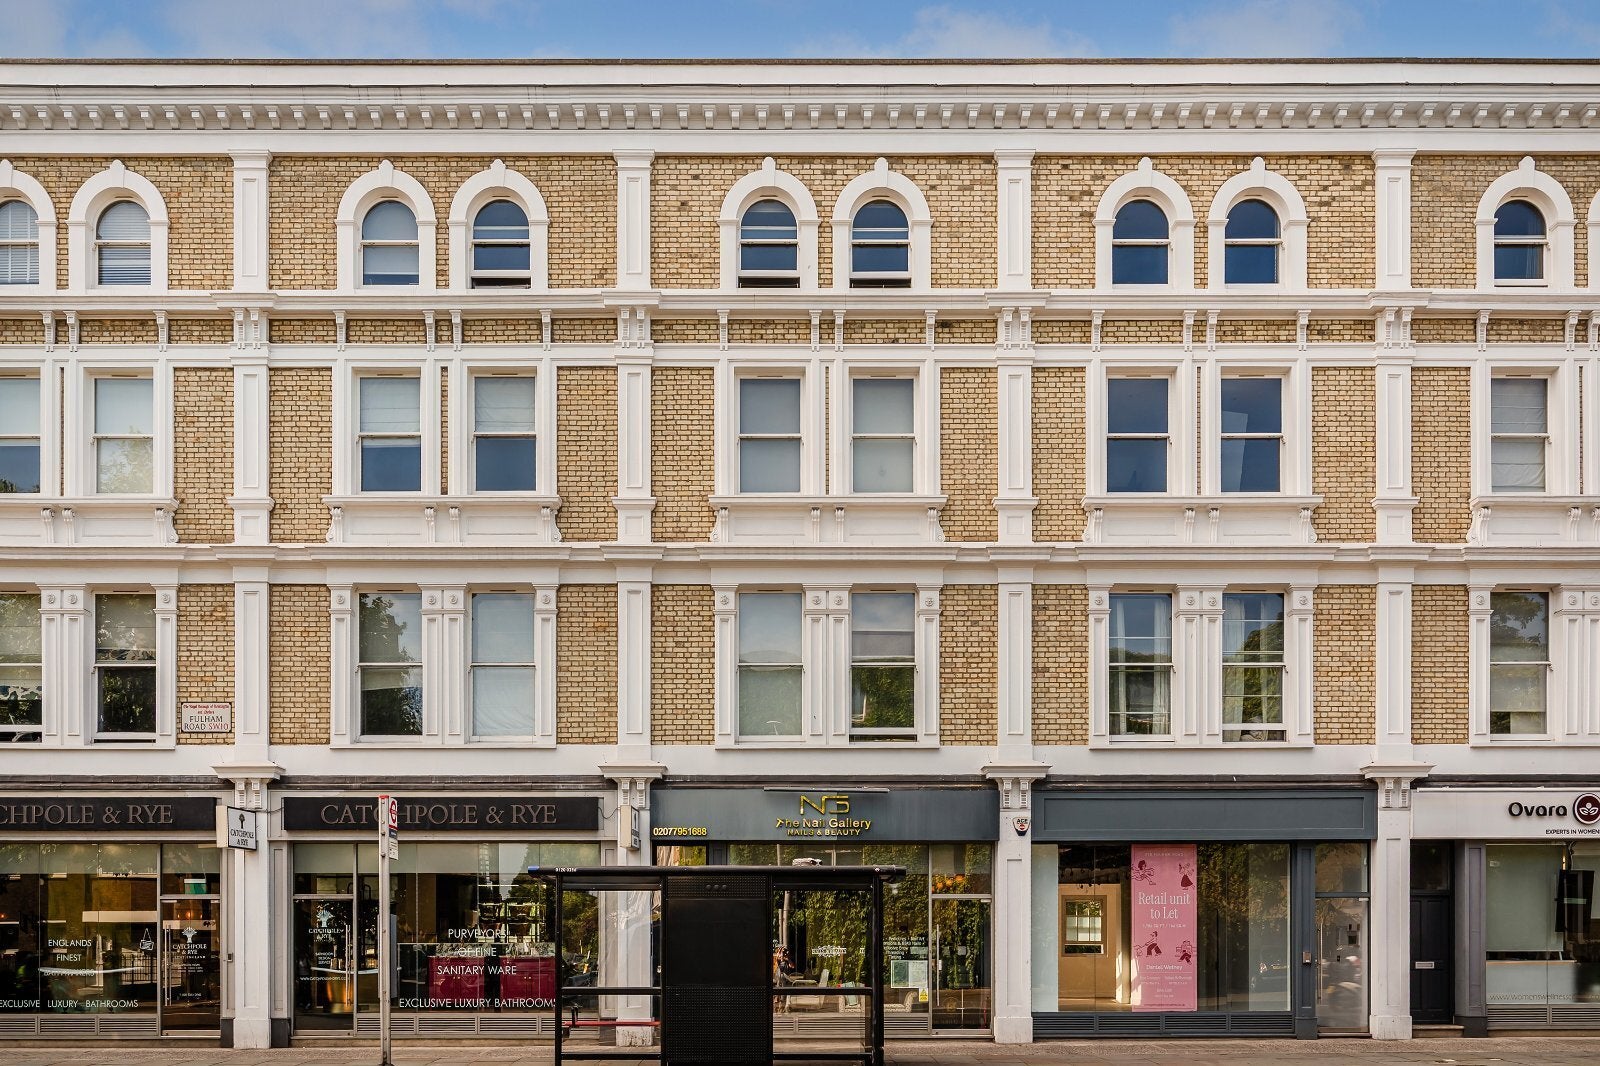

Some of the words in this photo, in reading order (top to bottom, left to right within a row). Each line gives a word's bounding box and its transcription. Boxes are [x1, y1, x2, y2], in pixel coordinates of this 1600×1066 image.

[102, 806, 122, 824] &
[126, 804, 173, 824] RYE
[486, 806, 505, 824] &
[510, 804, 557, 824] RYE
[1508, 802, 1568, 816] Ovara
[776, 818, 800, 828] The
[802, 818, 824, 828] Nail
[828, 818, 871, 830] Gallery
[653, 827, 707, 836] 02077951688
[1138, 892, 1167, 904] Retail
[1170, 892, 1191, 904] unit
[1150, 909, 1160, 919] to
[1163, 906, 1178, 919] Let
[448, 929, 507, 938] PURVEYORS
[458, 947, 472, 957] OF
[476, 947, 497, 957] FINE
[437, 966, 485, 975] SANITARY
[488, 966, 517, 975] WARE
[400, 998, 451, 1008] EXCLUSIVE
[455, 998, 490, 1008] LUXURY
